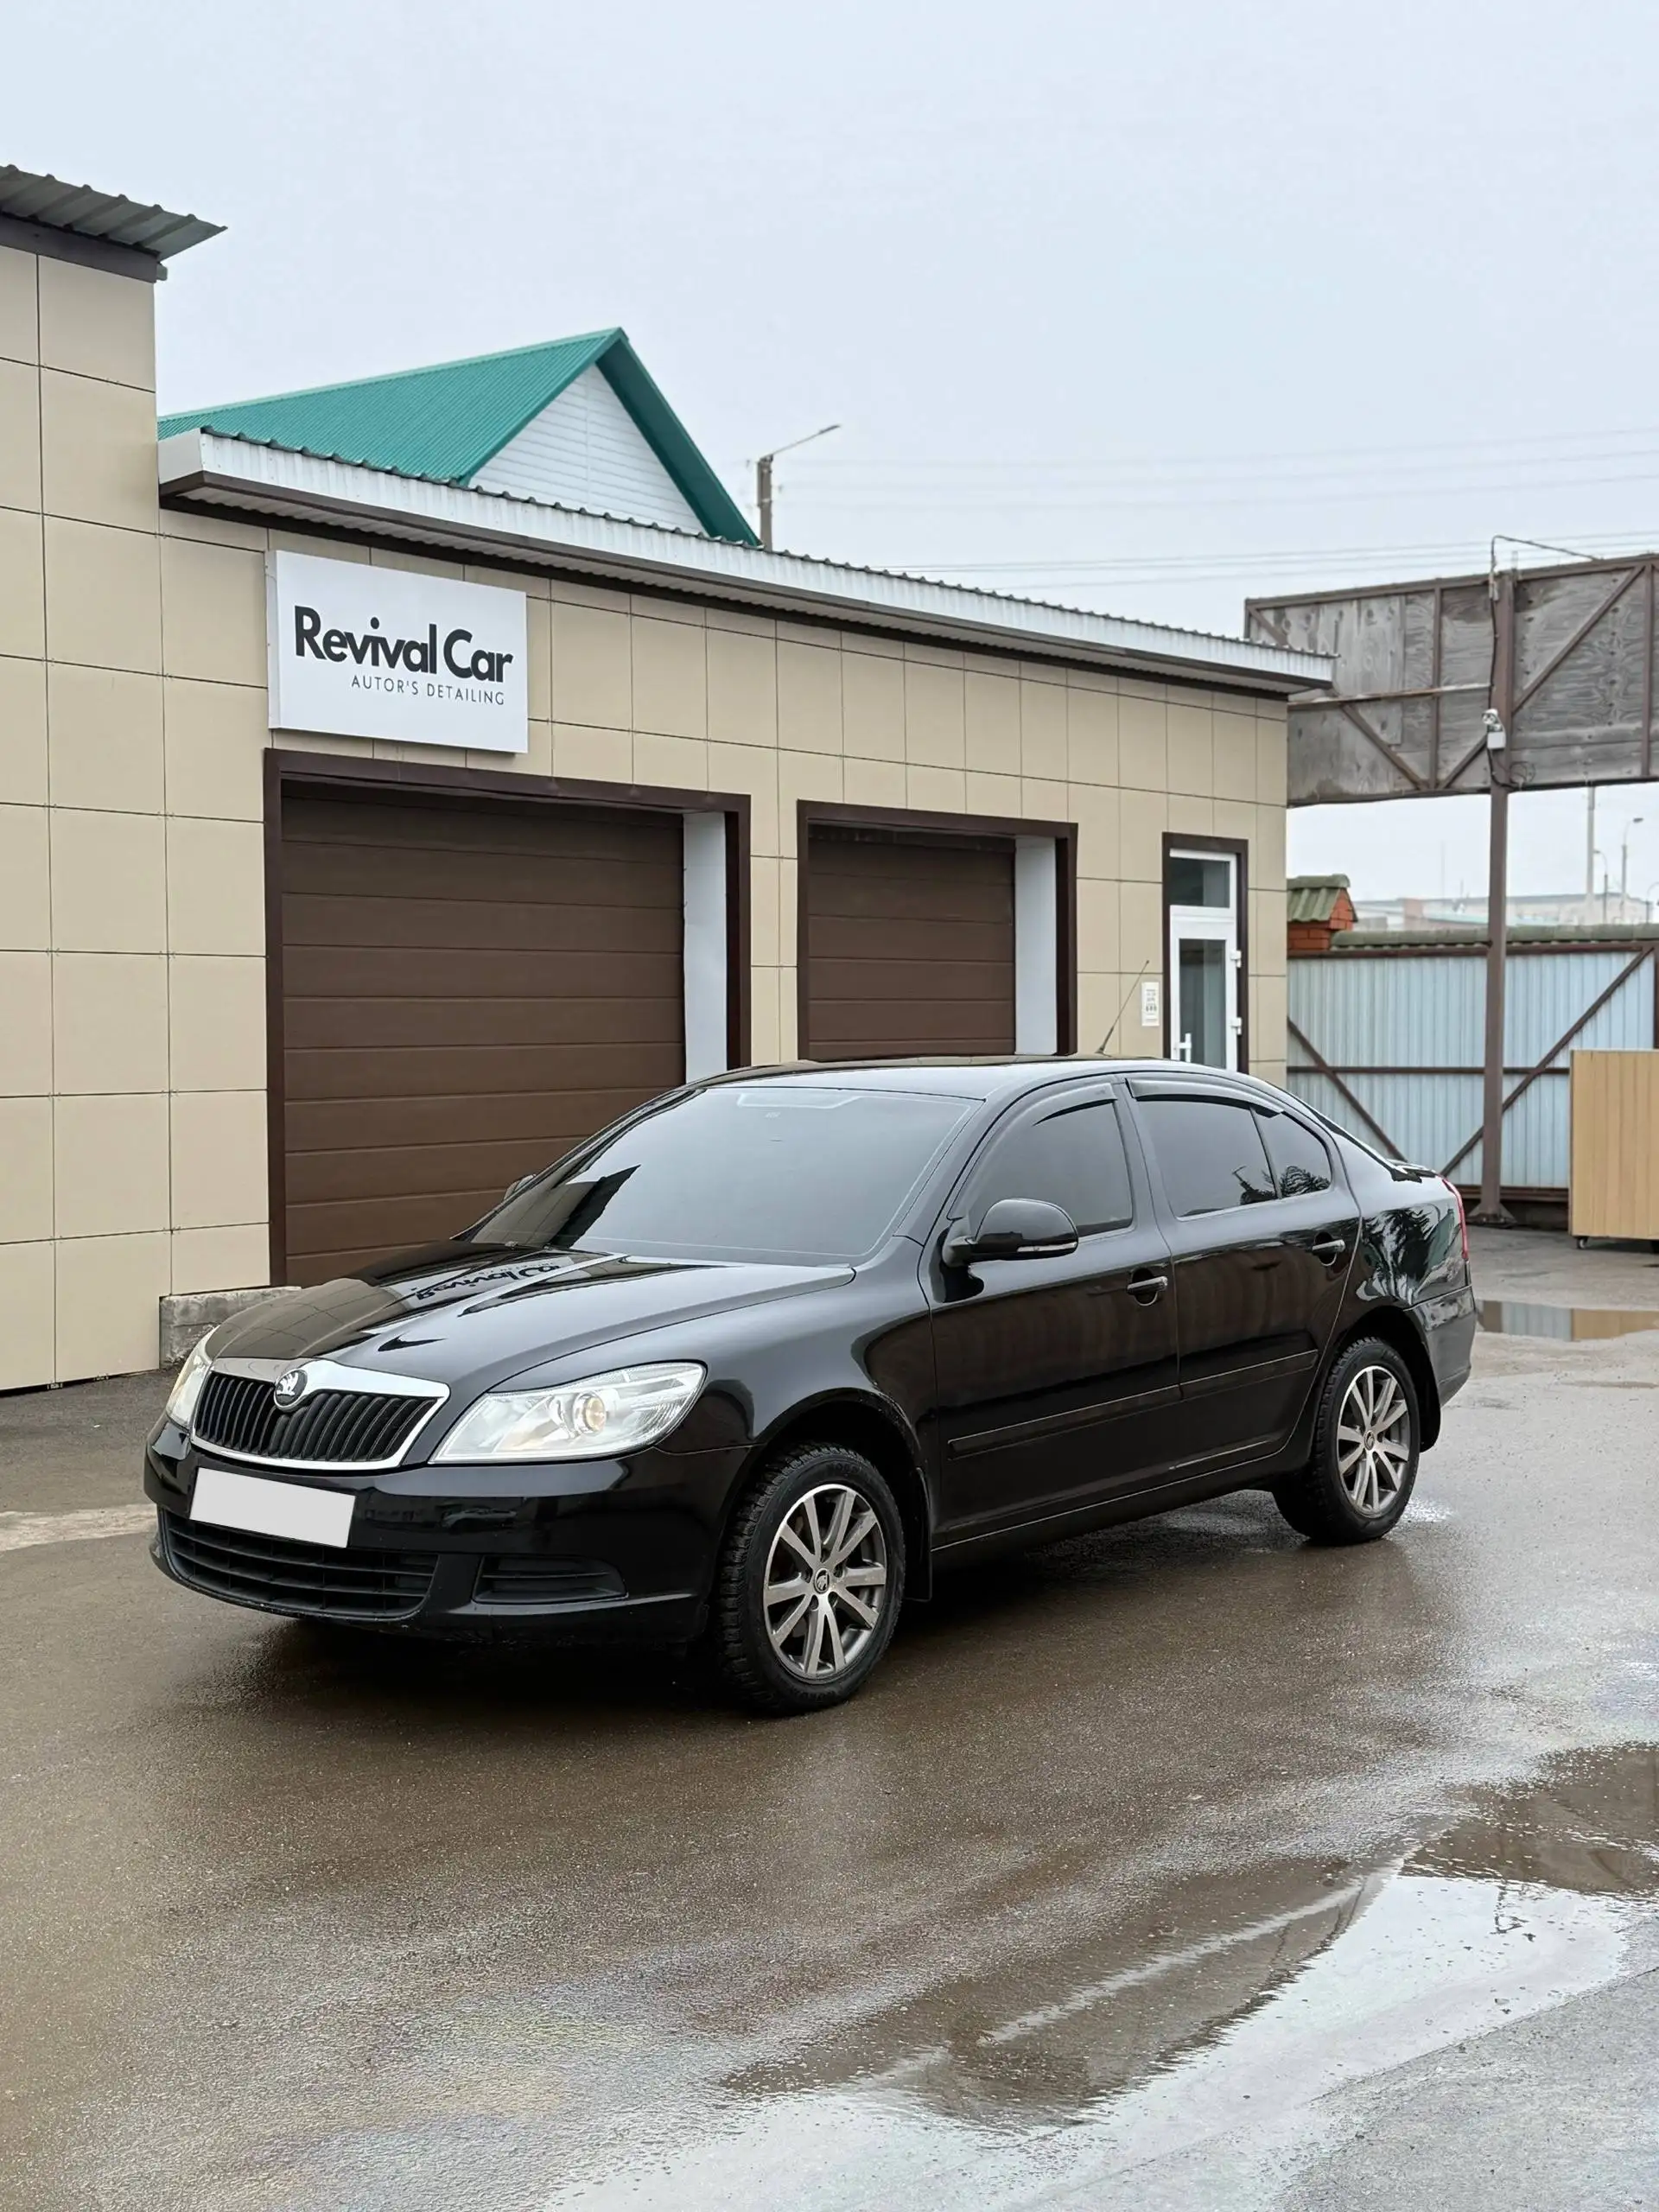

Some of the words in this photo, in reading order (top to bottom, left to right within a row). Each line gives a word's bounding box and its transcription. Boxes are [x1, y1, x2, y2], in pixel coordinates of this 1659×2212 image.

[295, 605, 437, 674] Revival
[443, 628, 513, 683] Car
[351, 675, 419, 695] AUTOR'S
[427, 683, 505, 705] DETAILING
